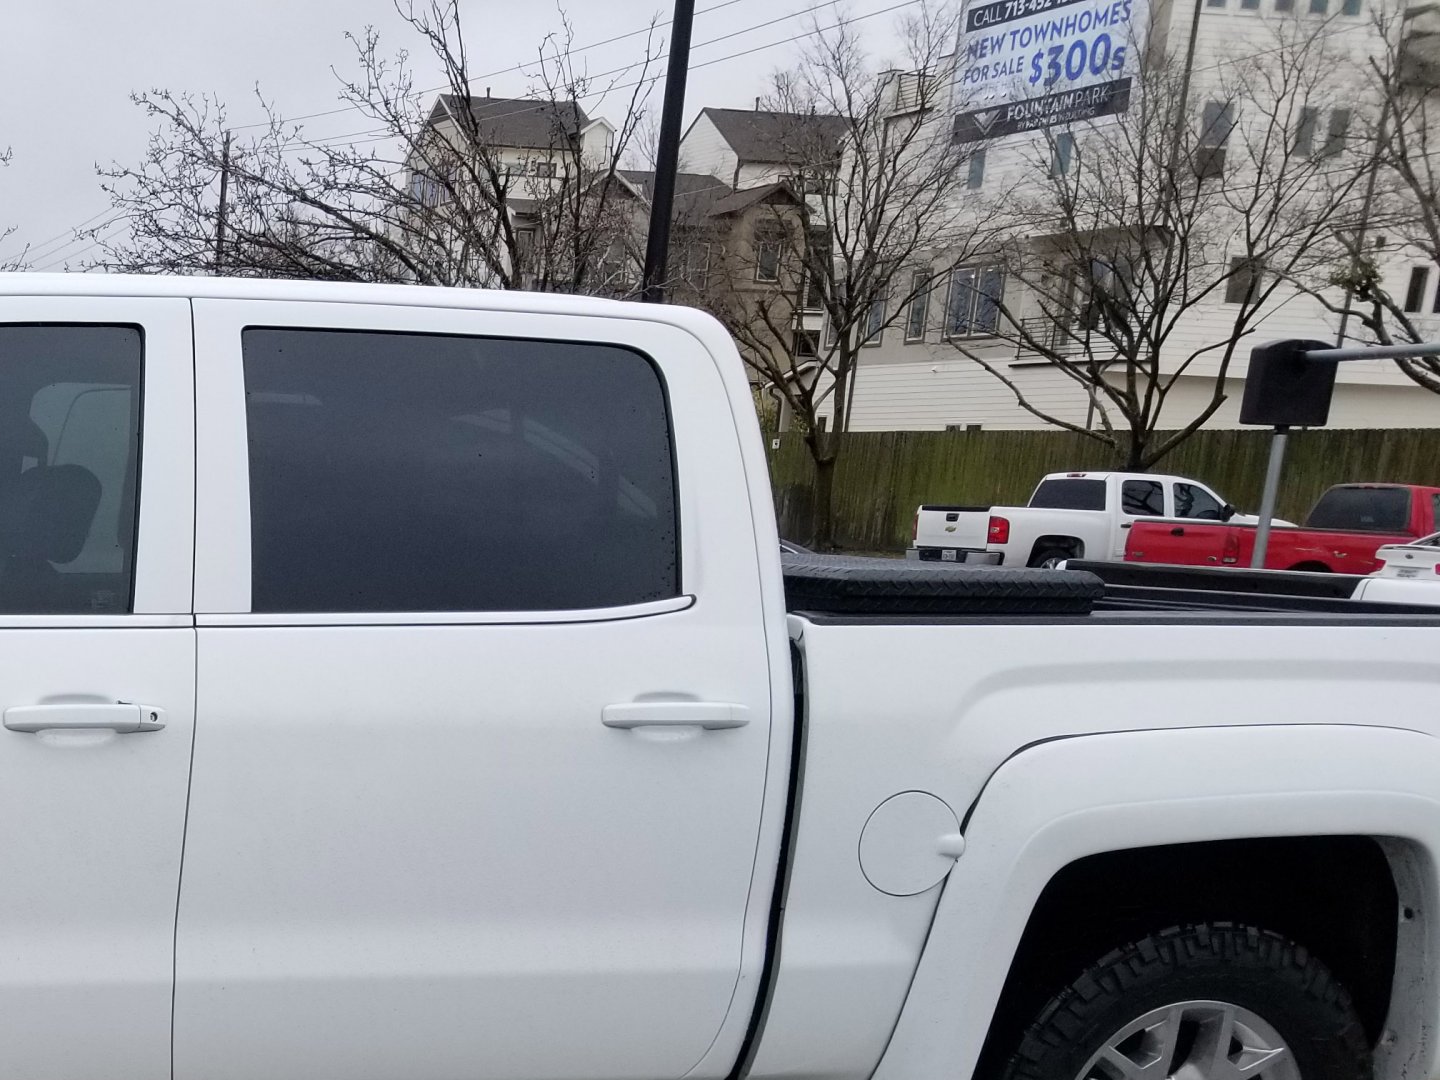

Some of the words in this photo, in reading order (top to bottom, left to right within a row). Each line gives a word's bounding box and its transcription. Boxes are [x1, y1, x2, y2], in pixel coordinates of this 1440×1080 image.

[973, 6, 1002, 27] CALL
[967, 32, 1006, 62] NEW
[1009, 0, 1132, 51] TOWNHOMES
[963, 64, 988, 86] FOR
[991, 56, 1024, 80] SALE
[1073, 85, 1110, 110] PARK
